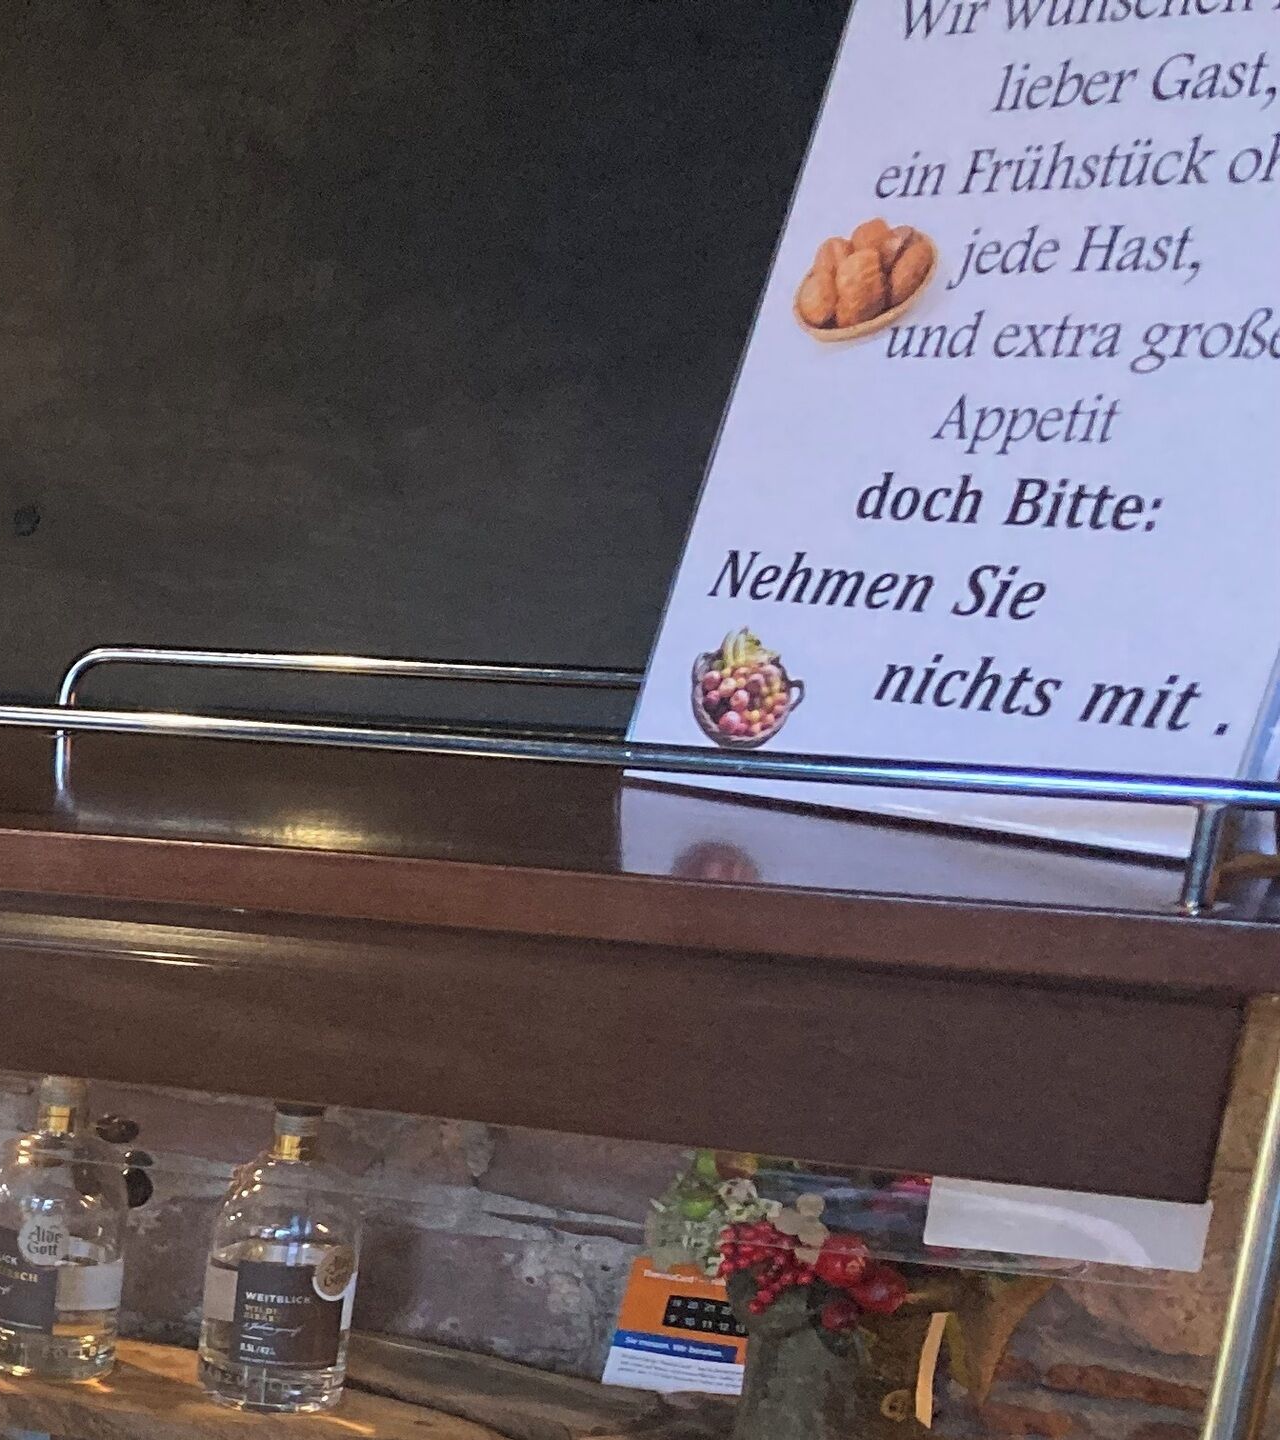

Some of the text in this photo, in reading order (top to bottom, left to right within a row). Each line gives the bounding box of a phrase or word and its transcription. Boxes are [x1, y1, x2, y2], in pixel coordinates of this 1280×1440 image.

[992, 52, 1279, 113] lieber Gast,
[874, 155, 946, 199] ein
[958, 134, 1216, 197] Frühstück
[946, 224, 1203, 290] jede Hast,
[886, 308, 983, 359] und
[992, 313, 1122, 359] extra
[931, 393, 1124, 455] Appetit
[855, 472, 1166, 533] doch Bitte:
[707, 549, 1049, 621] Nehmen Sie
[873, 653, 1065, 718] nichts
[1077, 673, 1205, 733] mit
[27, 1241, 58, 1257] Gott
[245, 1291, 312, 1304] WEITBLICK
